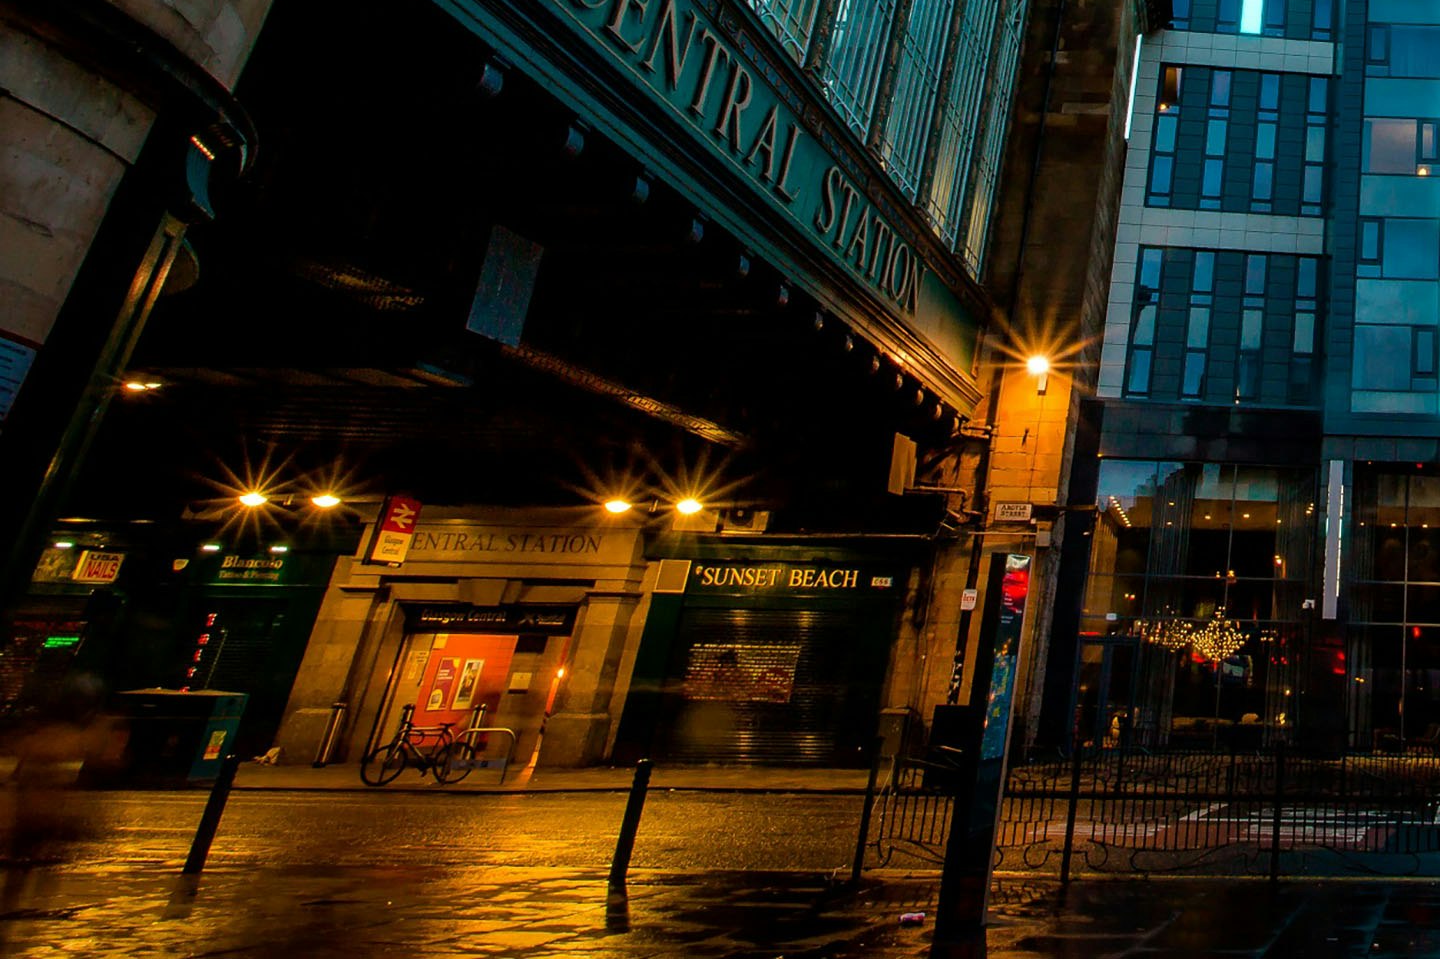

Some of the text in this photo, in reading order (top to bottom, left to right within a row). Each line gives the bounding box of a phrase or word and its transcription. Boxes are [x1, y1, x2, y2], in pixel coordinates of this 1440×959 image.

[816, 166, 928, 318] STATION
[409, 532, 603, 554] ENTRAL STATION
[90, 553, 119, 561] USA
[84, 561, 118, 578] NAILS
[701, 567, 860, 589] SUNSET BEACH
[420, 607, 507, 625] Glasgow Central
